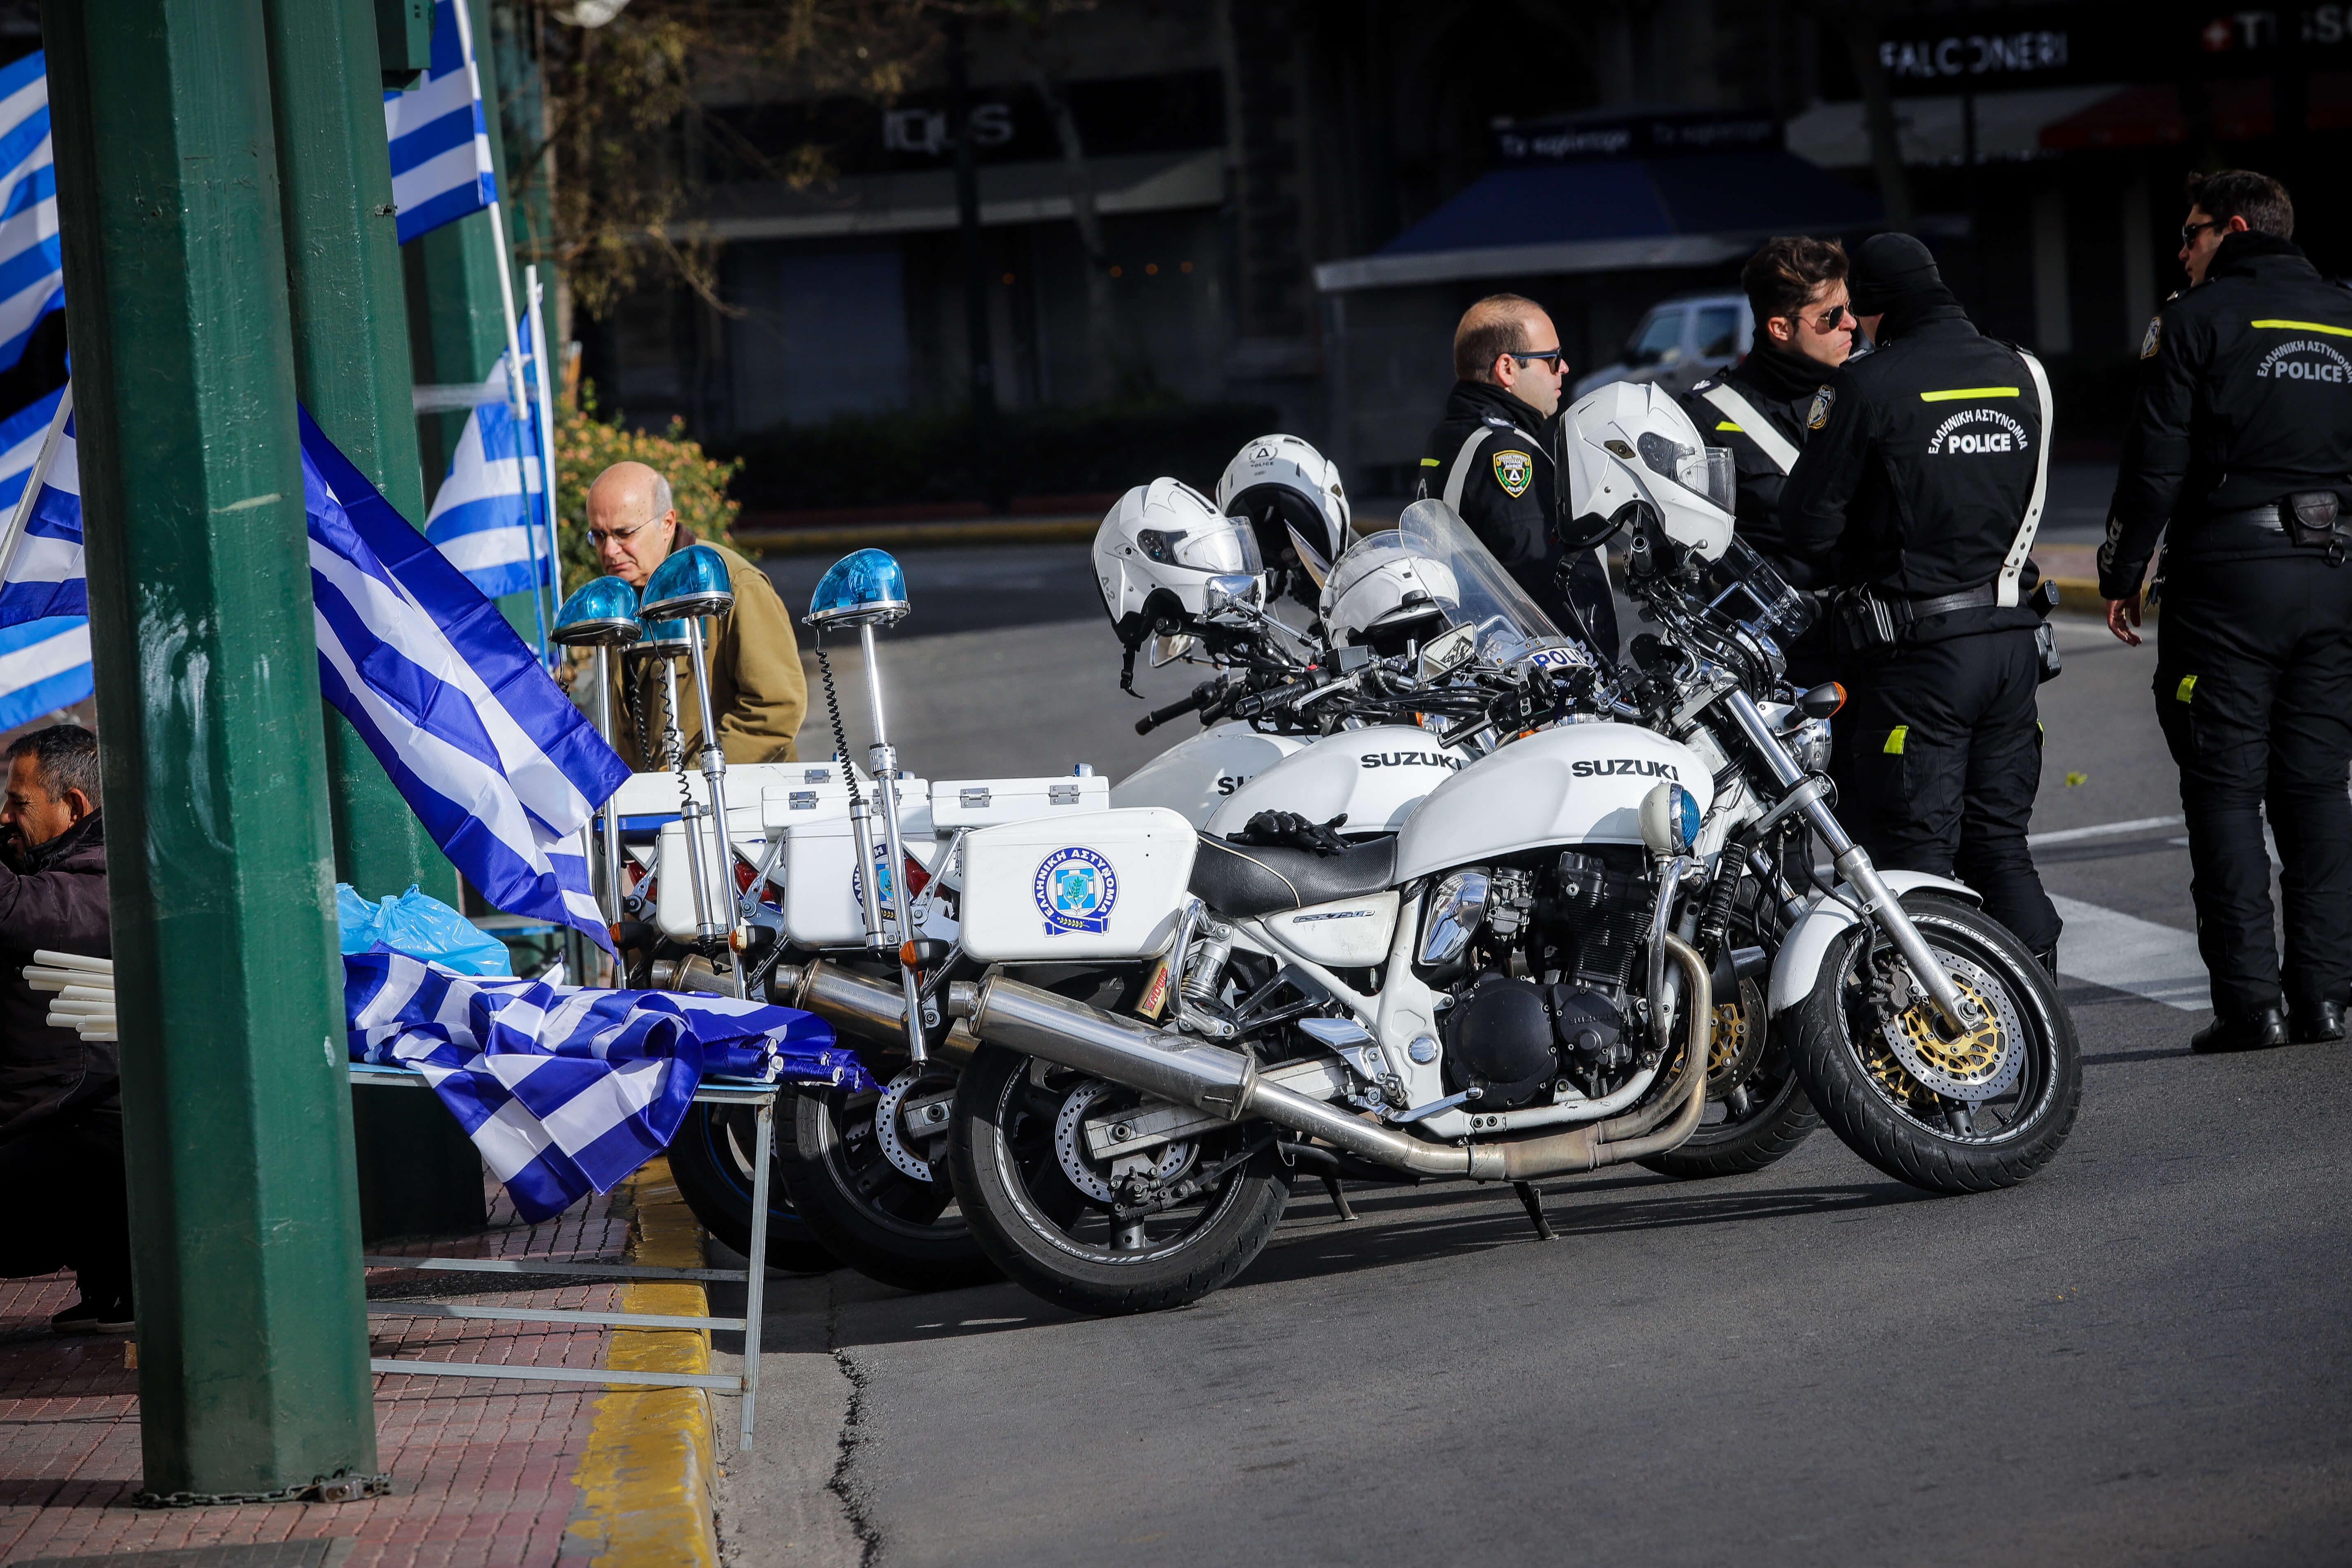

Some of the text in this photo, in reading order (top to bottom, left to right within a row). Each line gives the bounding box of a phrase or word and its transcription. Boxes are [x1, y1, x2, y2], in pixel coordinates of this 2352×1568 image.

[1879, 31, 2070, 79] FALCONERI
[2257, 340, 2306, 378] ΕΛΛΗΝΙΚΗ
[2275, 361, 2343, 383] POLICE
[1928, 409, 2028, 454] ΕΛΛΗΝΙΚΗ ΑΣΤΥΝΟΜΙΑ
[1948, 433, 2011, 454] POLICE
[1361, 752, 1462, 772] SUZUKI
[1572, 759, 1679, 782] SUZUKI
[1036, 849, 1115, 917] ΕΛΛΗΝΙΚΗ ΑΣΤΥΝΟΜΙΑ
[1953, 923, 1985, 942] POLICE
[1837, 956, 1849, 990] POLICE
[1143, 968, 1167, 1011] SHOWA
[1001, 1073, 1020, 1108] POLICE
[2045, 1070, 2056, 1101] POLICE
[1907, 1114, 1940, 1134] POLICE
[1054, 1239, 1089, 1258] POLICE
